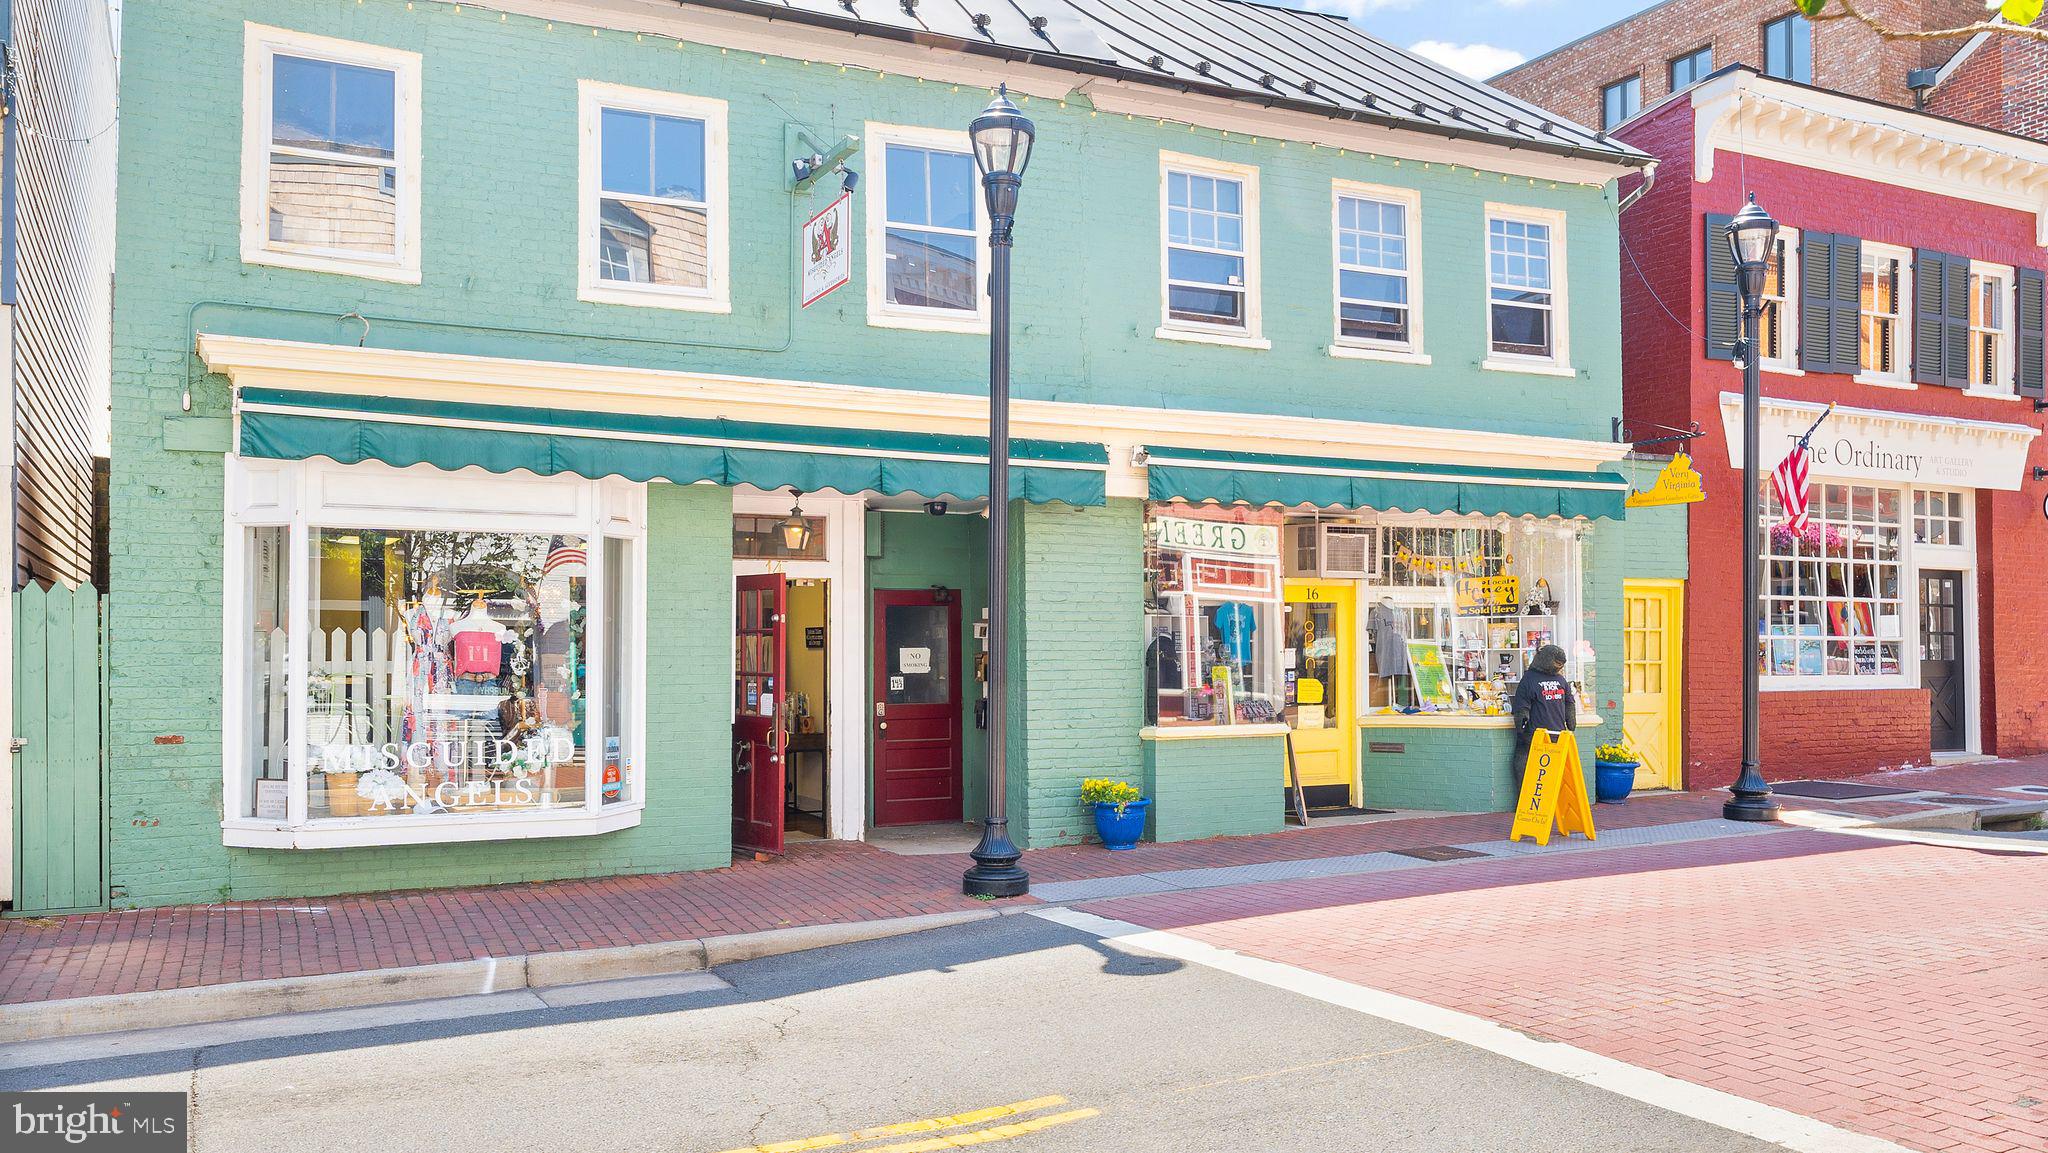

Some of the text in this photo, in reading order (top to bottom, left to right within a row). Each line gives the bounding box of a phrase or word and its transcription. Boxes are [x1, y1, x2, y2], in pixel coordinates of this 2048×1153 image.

[1834, 438, 1923, 478] Ordinary
[1929, 455, 1974, 468] ART GALLERY
[1669, 467, 1689, 480] Very
[1942, 467, 1968, 478] STUDIO
[1663, 479, 1696, 491] Virginia
[1306, 588, 1319, 600] 16
[1456, 580, 1517, 603] Honey
[1468, 605, 1517, 615] Sold Here
[909, 652, 922, 660] NO
[322, 737, 576, 772] MISGUIDED
[1529, 753, 1551, 811] OPEN
[368, 778, 533, 811] ANGELS
